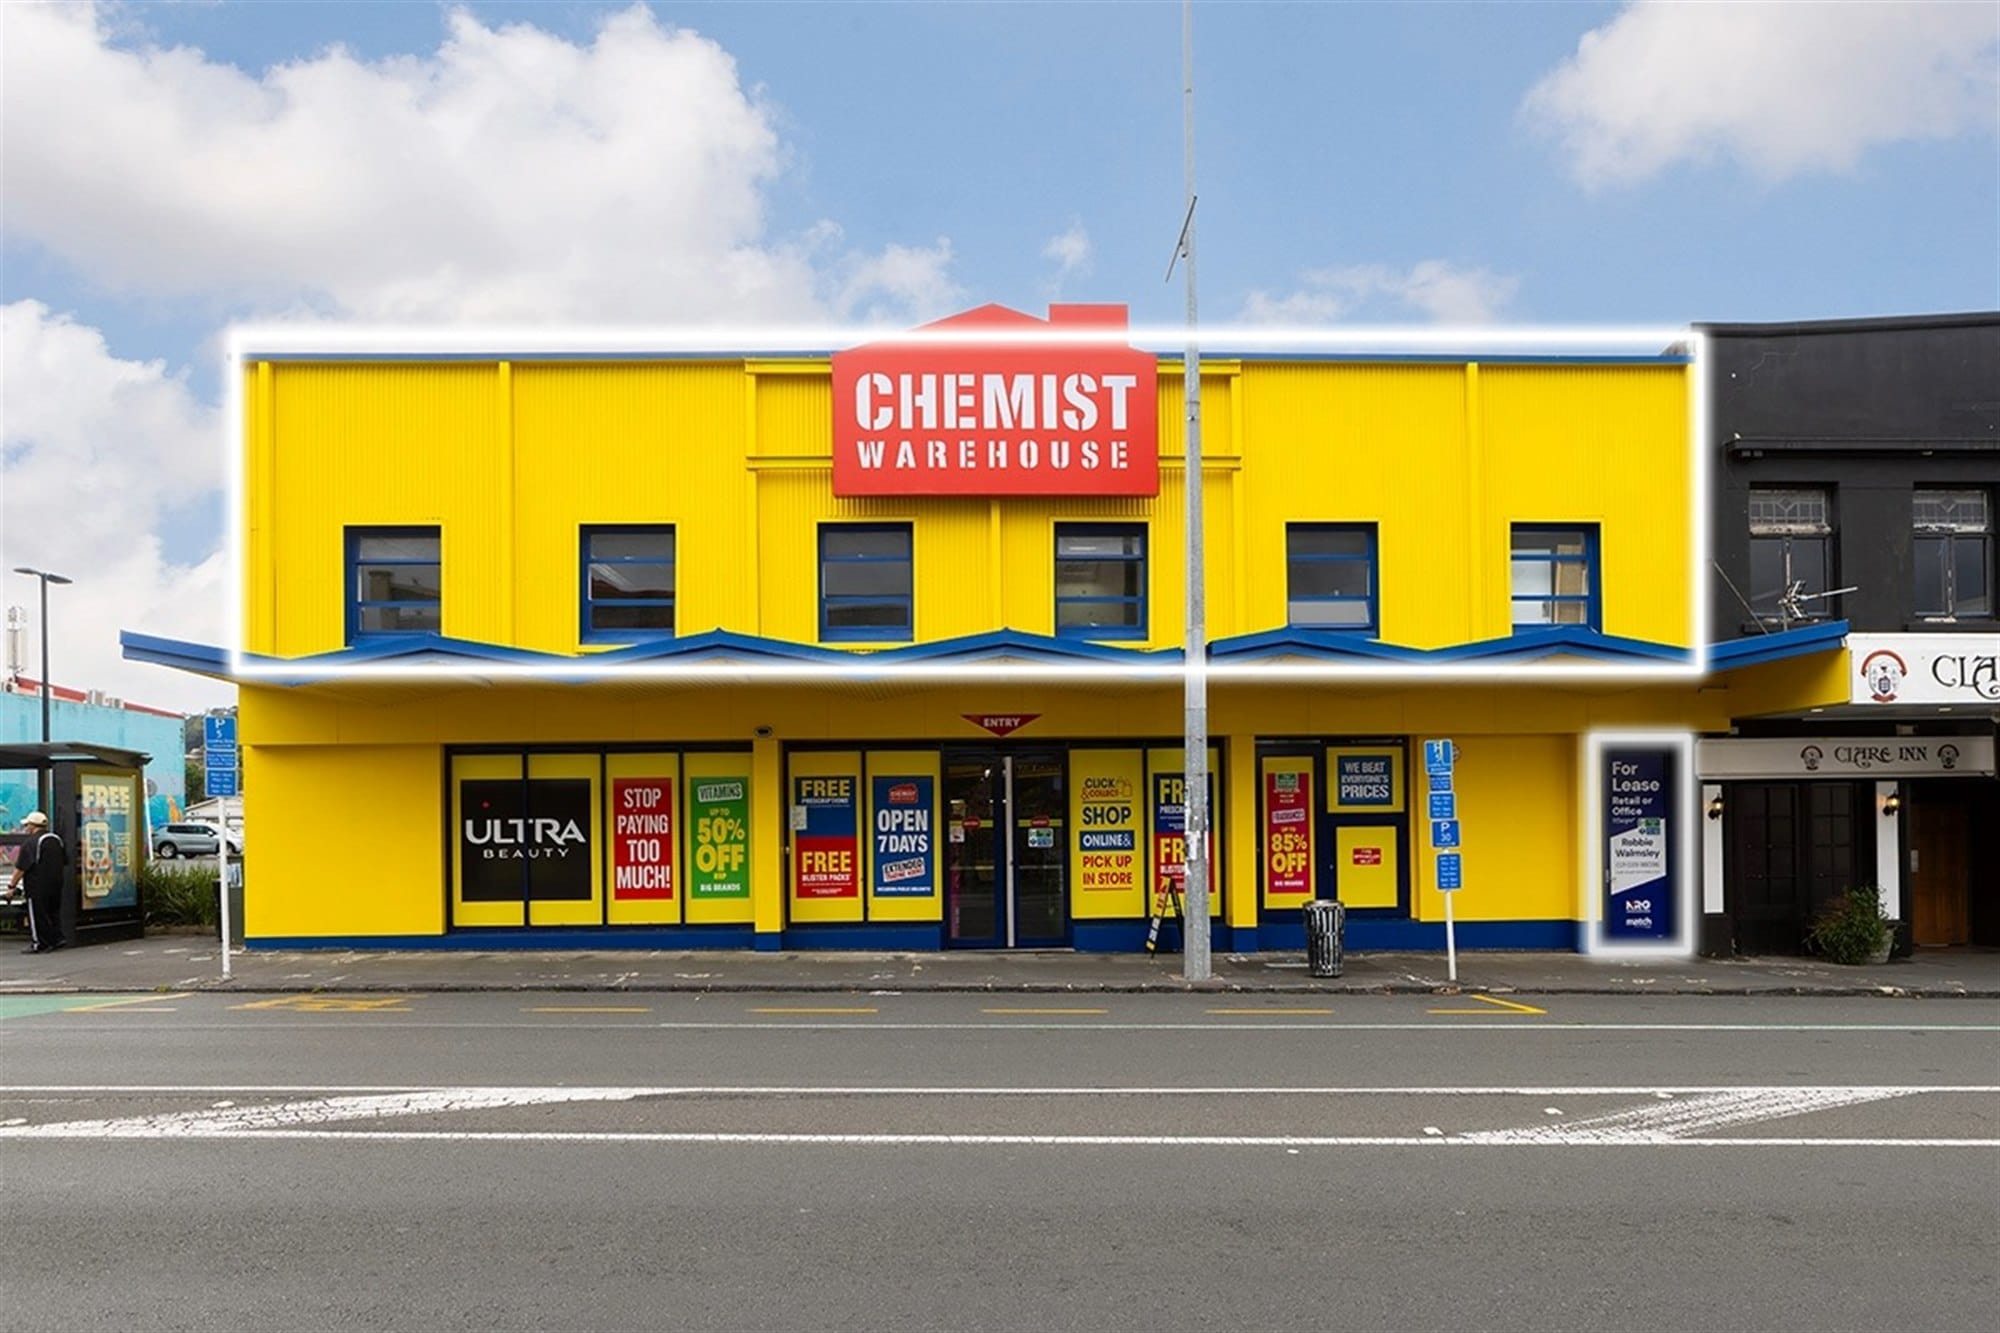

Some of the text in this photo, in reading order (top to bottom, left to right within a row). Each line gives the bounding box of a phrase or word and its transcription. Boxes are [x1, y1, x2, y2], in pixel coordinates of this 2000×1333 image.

[855, 373, 1137, 431] CHEMIST
[856, 440, 1128, 469] WAREHOUSE
[983, 718, 1021, 727] ENTRY
[1834, 747, 1928, 768] CLARE INN
[1344, 762, 1386, 774] WE BEAT
[1612, 761, 1639, 775] For
[698, 782, 741, 801] VITAMINS
[801, 780, 851, 797] FREE
[1085, 778, 1116, 789] CLICK
[1341, 785, 1390, 798] PRICES
[1612, 778, 1661, 792] Lease
[82, 784, 130, 809] FREE
[623, 787, 662, 808] STOP
[617, 815, 669, 834] PAYING
[877, 808, 928, 833] OPEN
[1082, 806, 1132, 825] SHOP
[465, 818, 587, 846] ULTRA
[697, 817, 745, 844] 50%
[1440, 822, 1451, 832] P
[626, 838, 660, 863] TOO
[1271, 833, 1308, 852] 85%
[483, 848, 569, 859] BEAUTY
[695, 844, 745, 873] OFF
[802, 851, 852, 873] FREE
[1082, 855, 1133, 868] PICK UP
[1271, 852, 1307, 873] OFF
[616, 865, 671, 889] MUCH!
[1083, 871, 1133, 885] IN STORE
